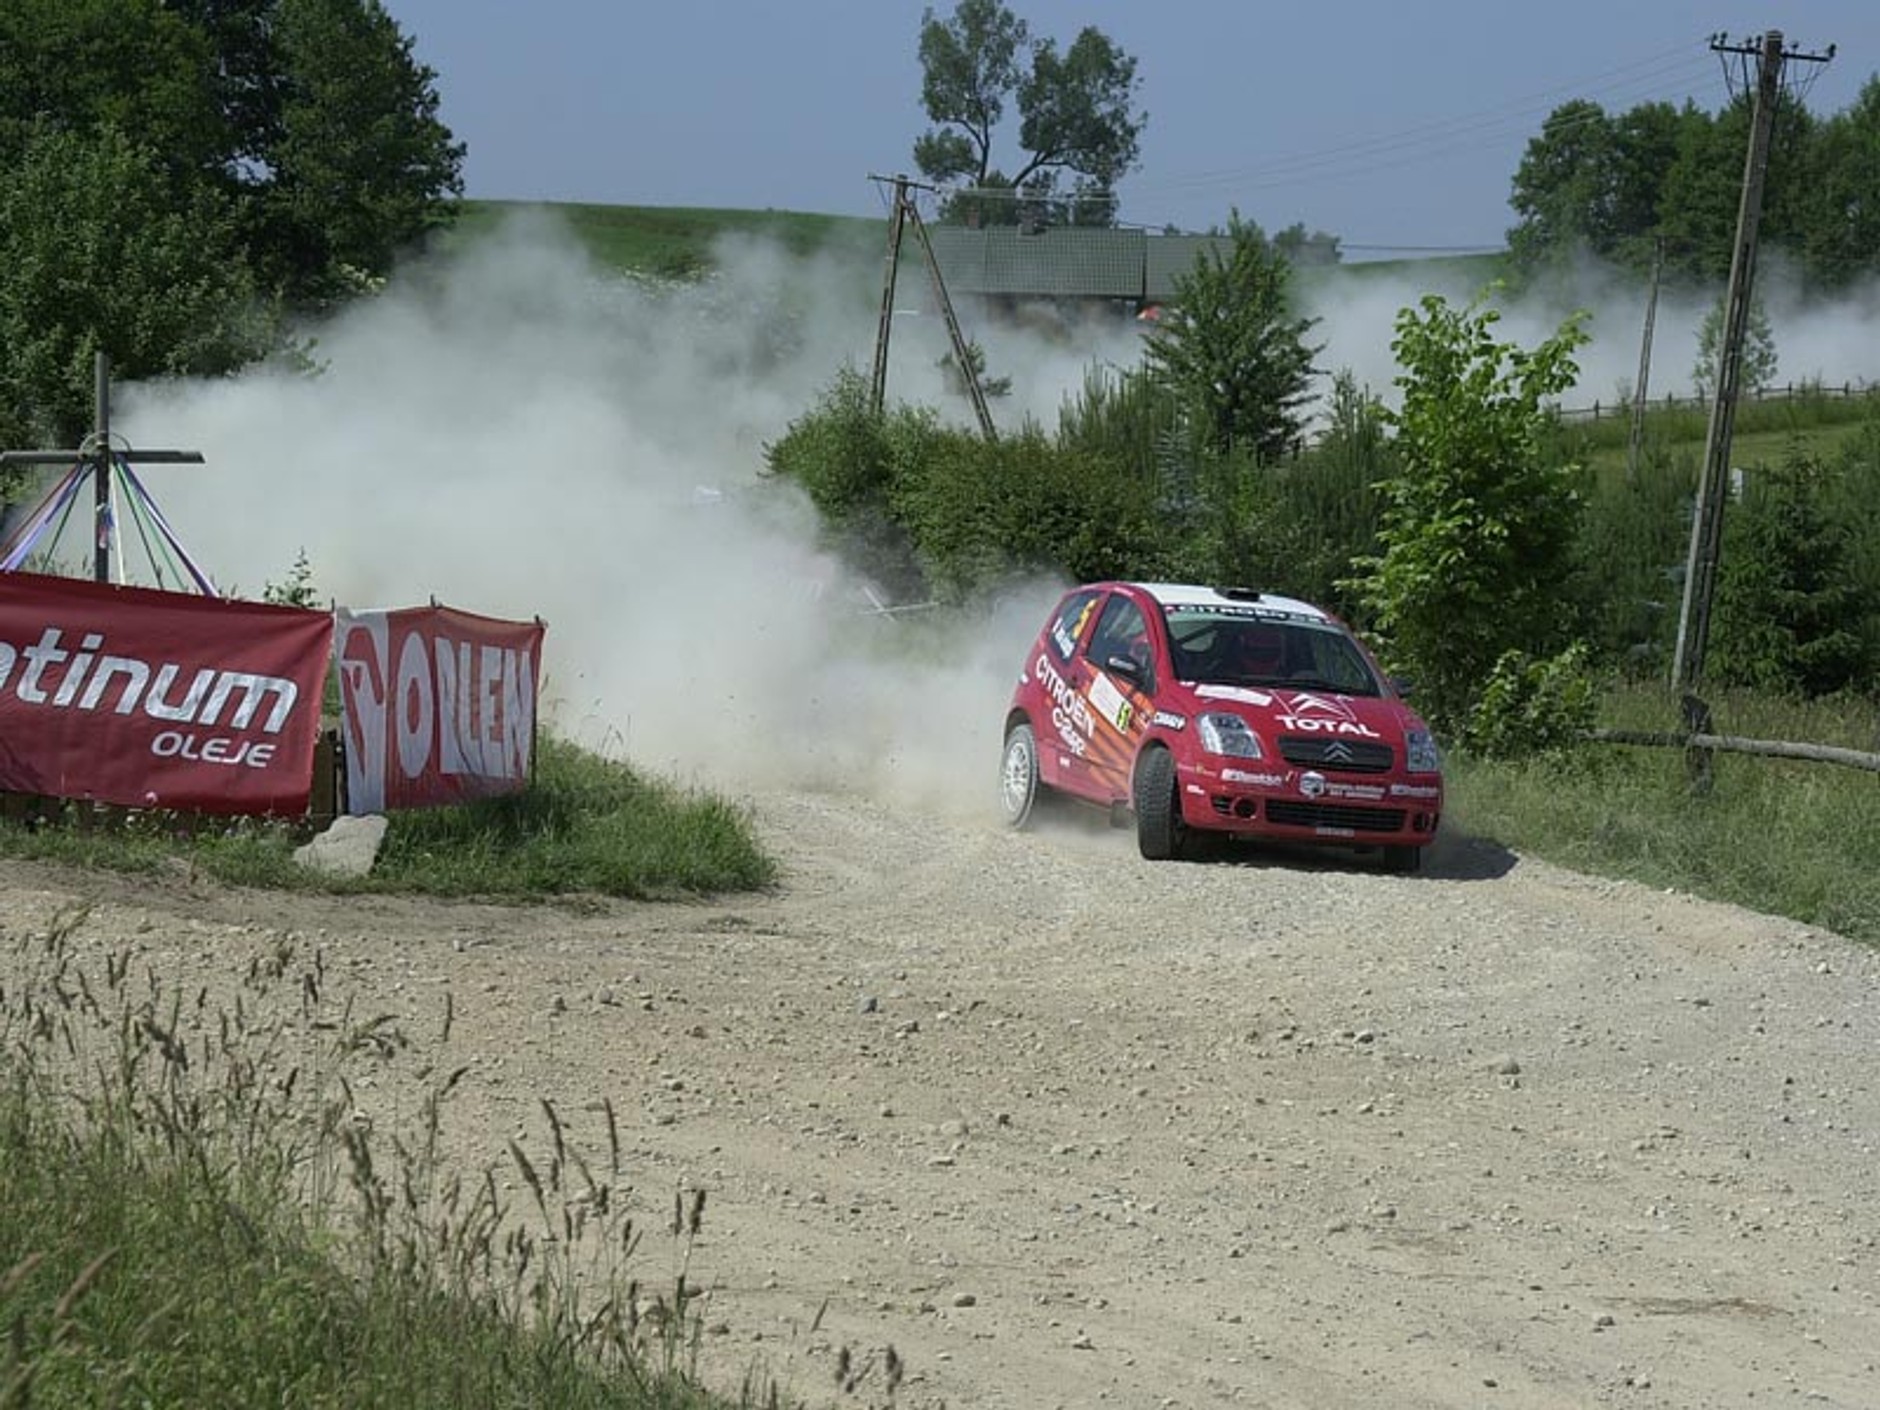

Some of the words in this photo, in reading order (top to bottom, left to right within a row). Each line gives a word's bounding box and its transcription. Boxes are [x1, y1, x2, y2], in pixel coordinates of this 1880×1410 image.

[397, 630, 534, 779] ORLEN
[1274, 714, 1381, 738] TOTAL
[151, 731, 277, 769] OLEJE
